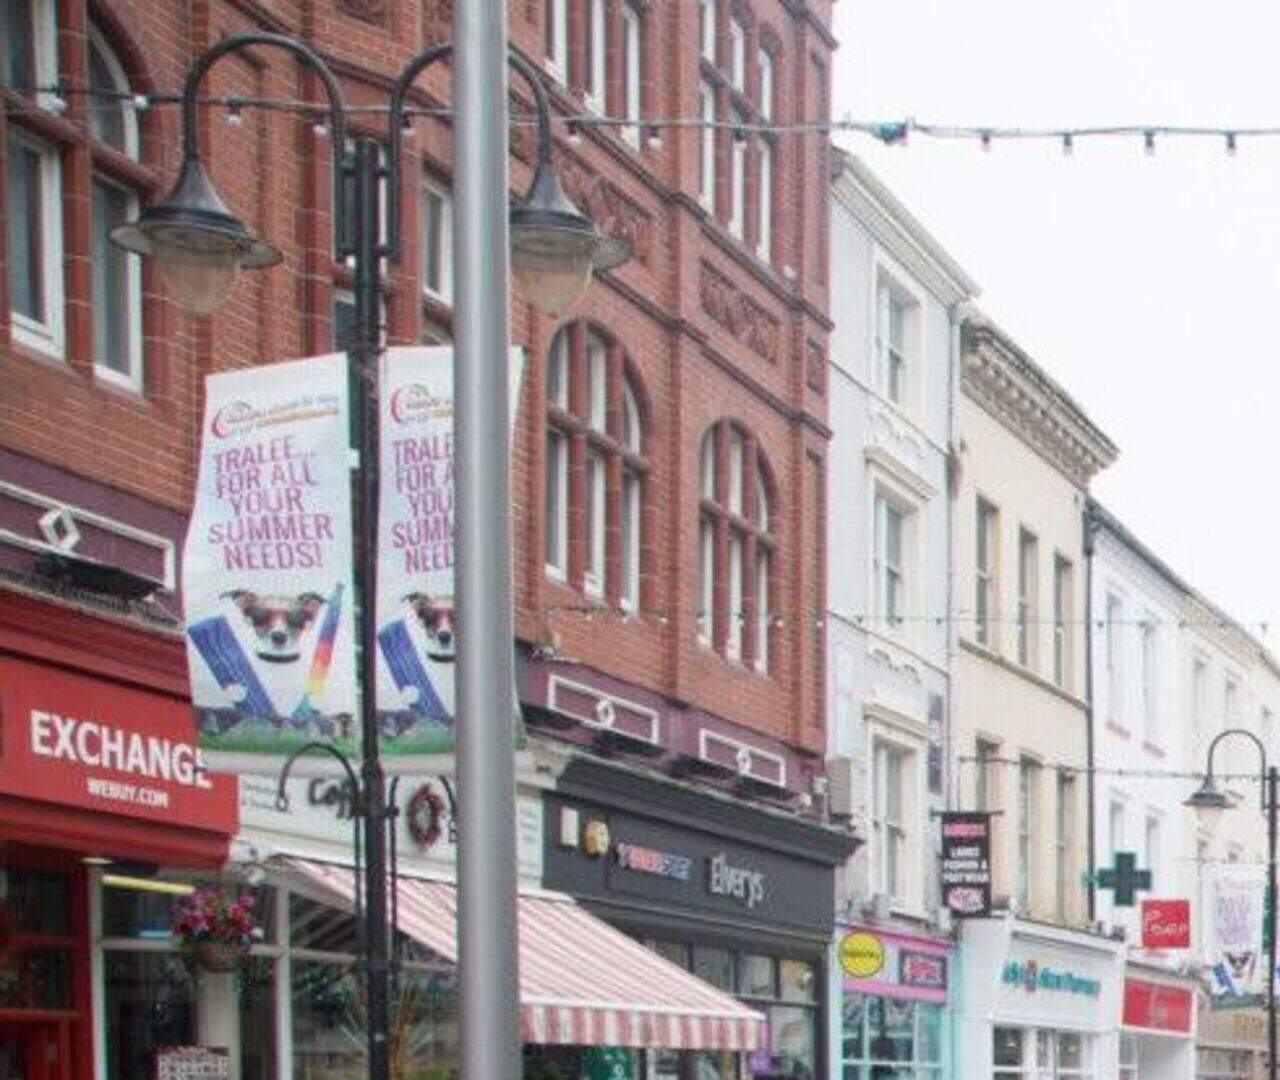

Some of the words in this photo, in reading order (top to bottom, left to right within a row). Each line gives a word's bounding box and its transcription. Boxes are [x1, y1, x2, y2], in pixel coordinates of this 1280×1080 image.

[393, 432, 455, 467] TRALE
[217, 466, 261, 498] FOR
[270, 457, 318, 486] ALL
[396, 463, 434, 494] FOR
[229, 488, 304, 517] YOUR
[407, 492, 453, 517] YOU
[207, 513, 334, 545] SUMMER
[223, 541, 323, 571] NEEDS!
